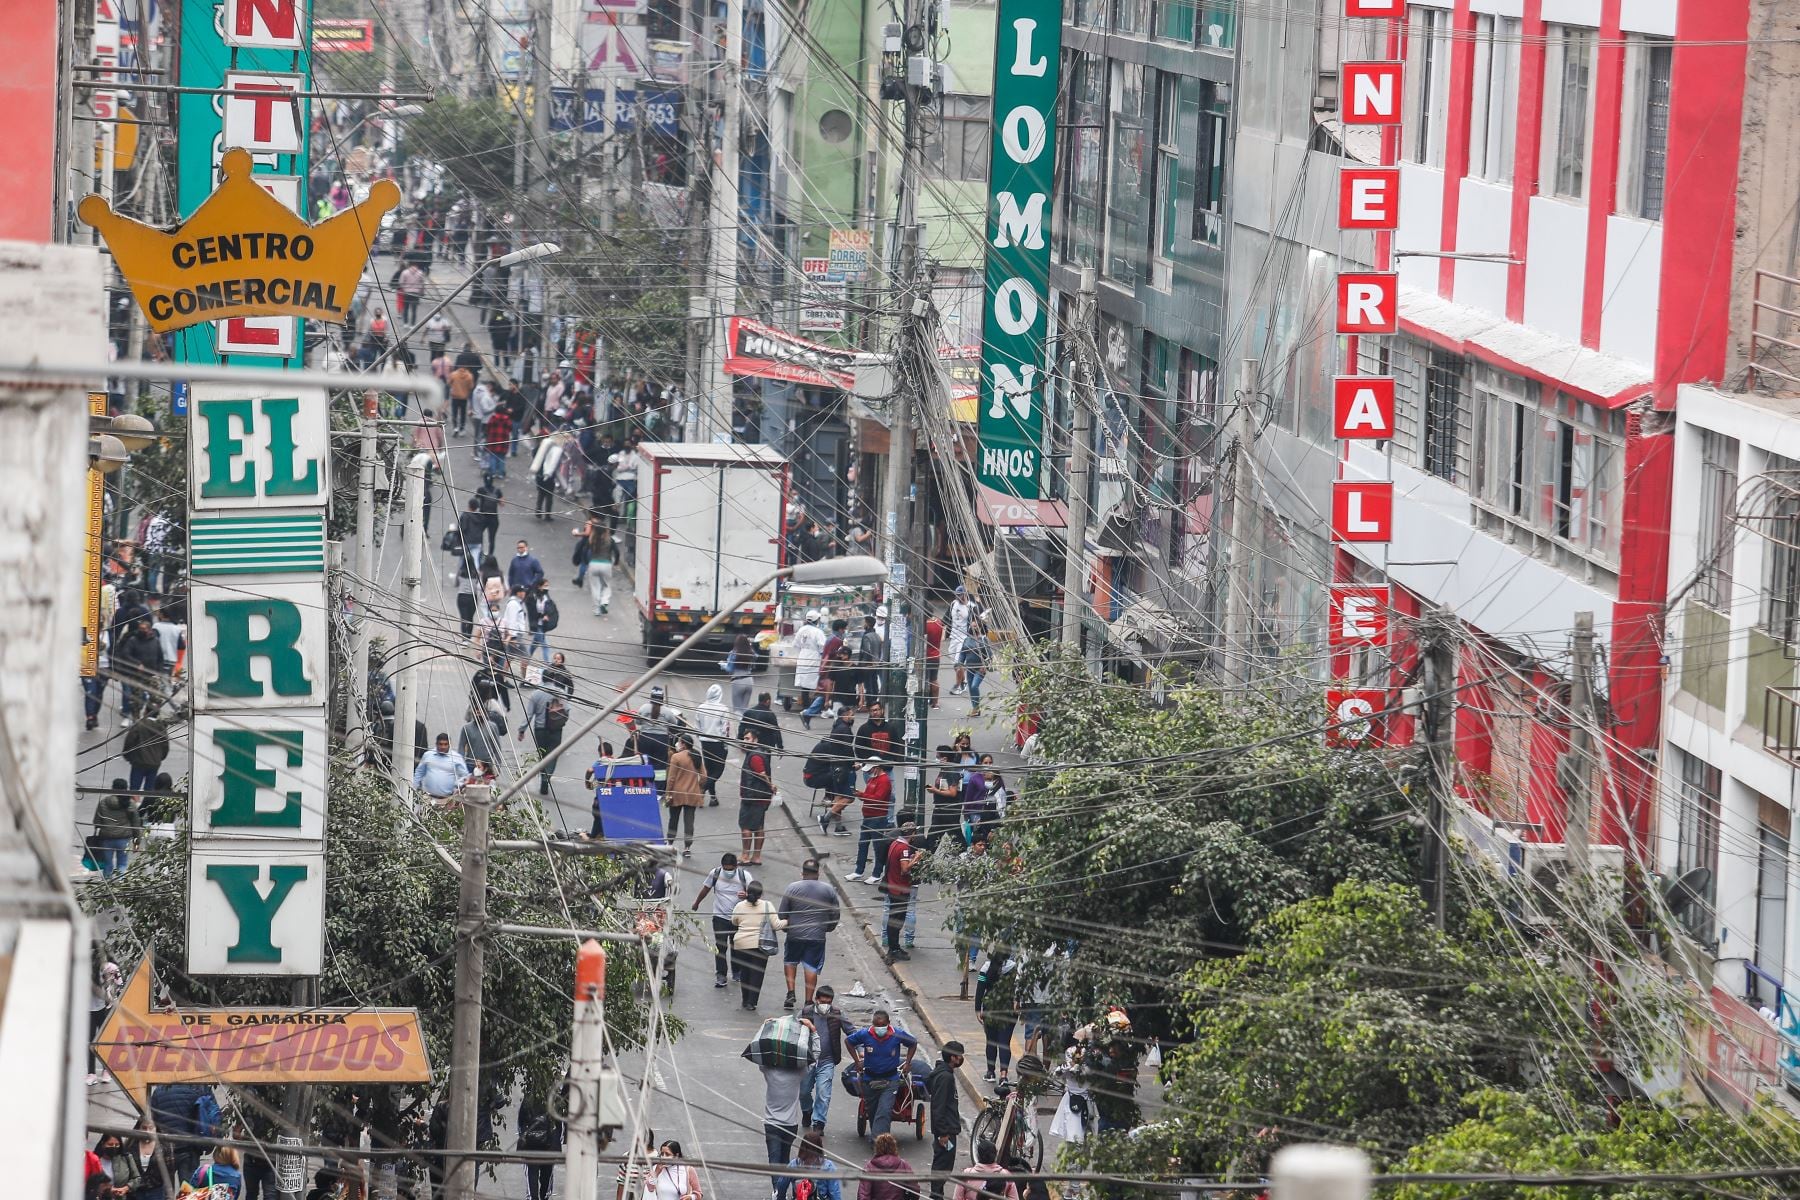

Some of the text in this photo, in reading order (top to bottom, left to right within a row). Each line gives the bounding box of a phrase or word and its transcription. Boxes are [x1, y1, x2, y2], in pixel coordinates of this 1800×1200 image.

[172, 233, 314, 270] CENTRO
[149, 278, 341, 321] COMERCIAL
[1338, 0, 1393, 741] NERALES
[983, 448, 1034, 477] HNOS
[199, 399, 318, 962] EL REY
[182, 1014, 347, 1026] DE GAMARRA
[107, 1024, 410, 1072] BIENVENIDOS
